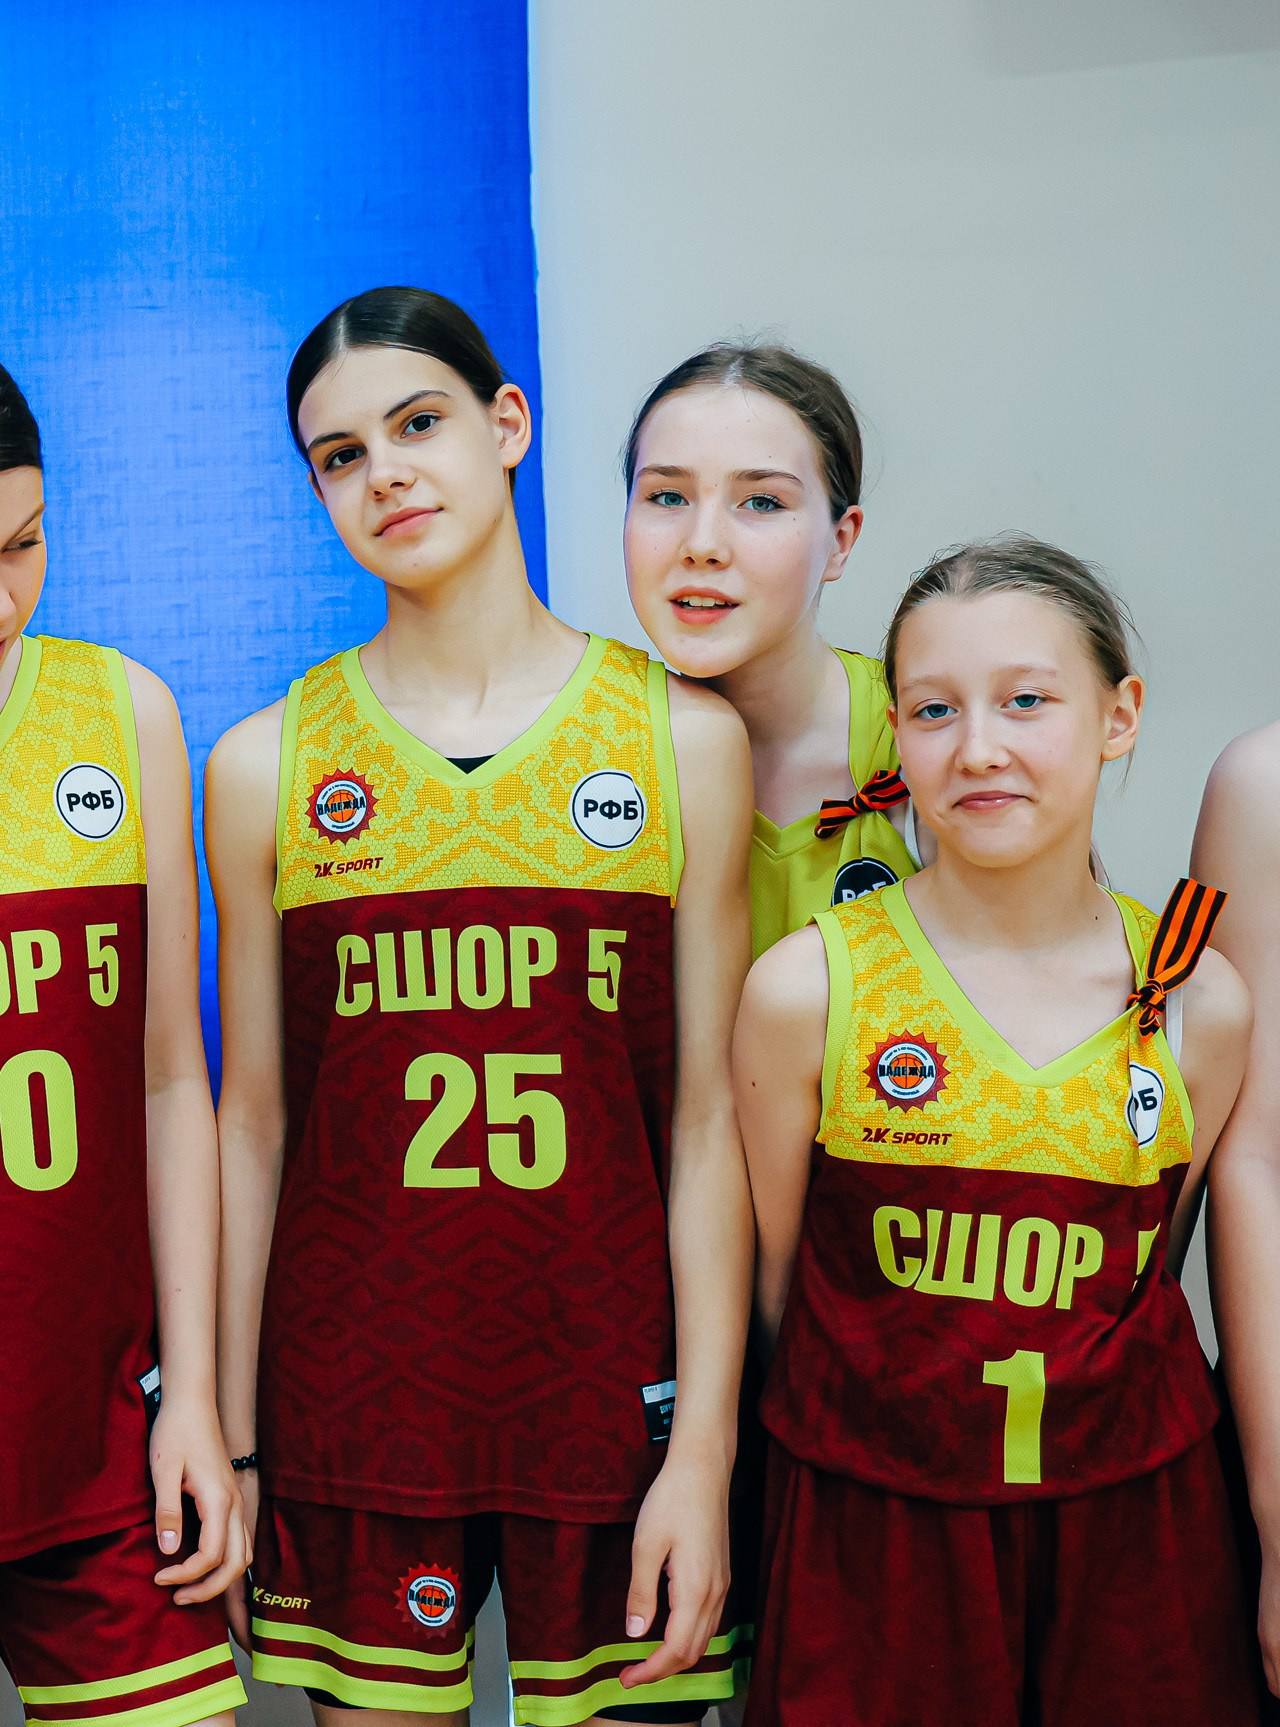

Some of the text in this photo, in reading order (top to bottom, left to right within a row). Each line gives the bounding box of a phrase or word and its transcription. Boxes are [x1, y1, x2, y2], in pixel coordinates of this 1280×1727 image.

[67, 789, 115, 812] РФБ
[583, 798, 639, 821] РФБ
[336, 857, 384, 875] SPORT
[86, 924, 118, 1006] 5
[336, 925, 626, 1016] СШОР 5
[404, 1053, 566, 1189] 25
[862, 1128, 952, 1145] 2K SPORT
[873, 1206, 1103, 1309] СШОР
[983, 1350, 1045, 1483] 1
[262, 1593, 311, 1610] SPORT
